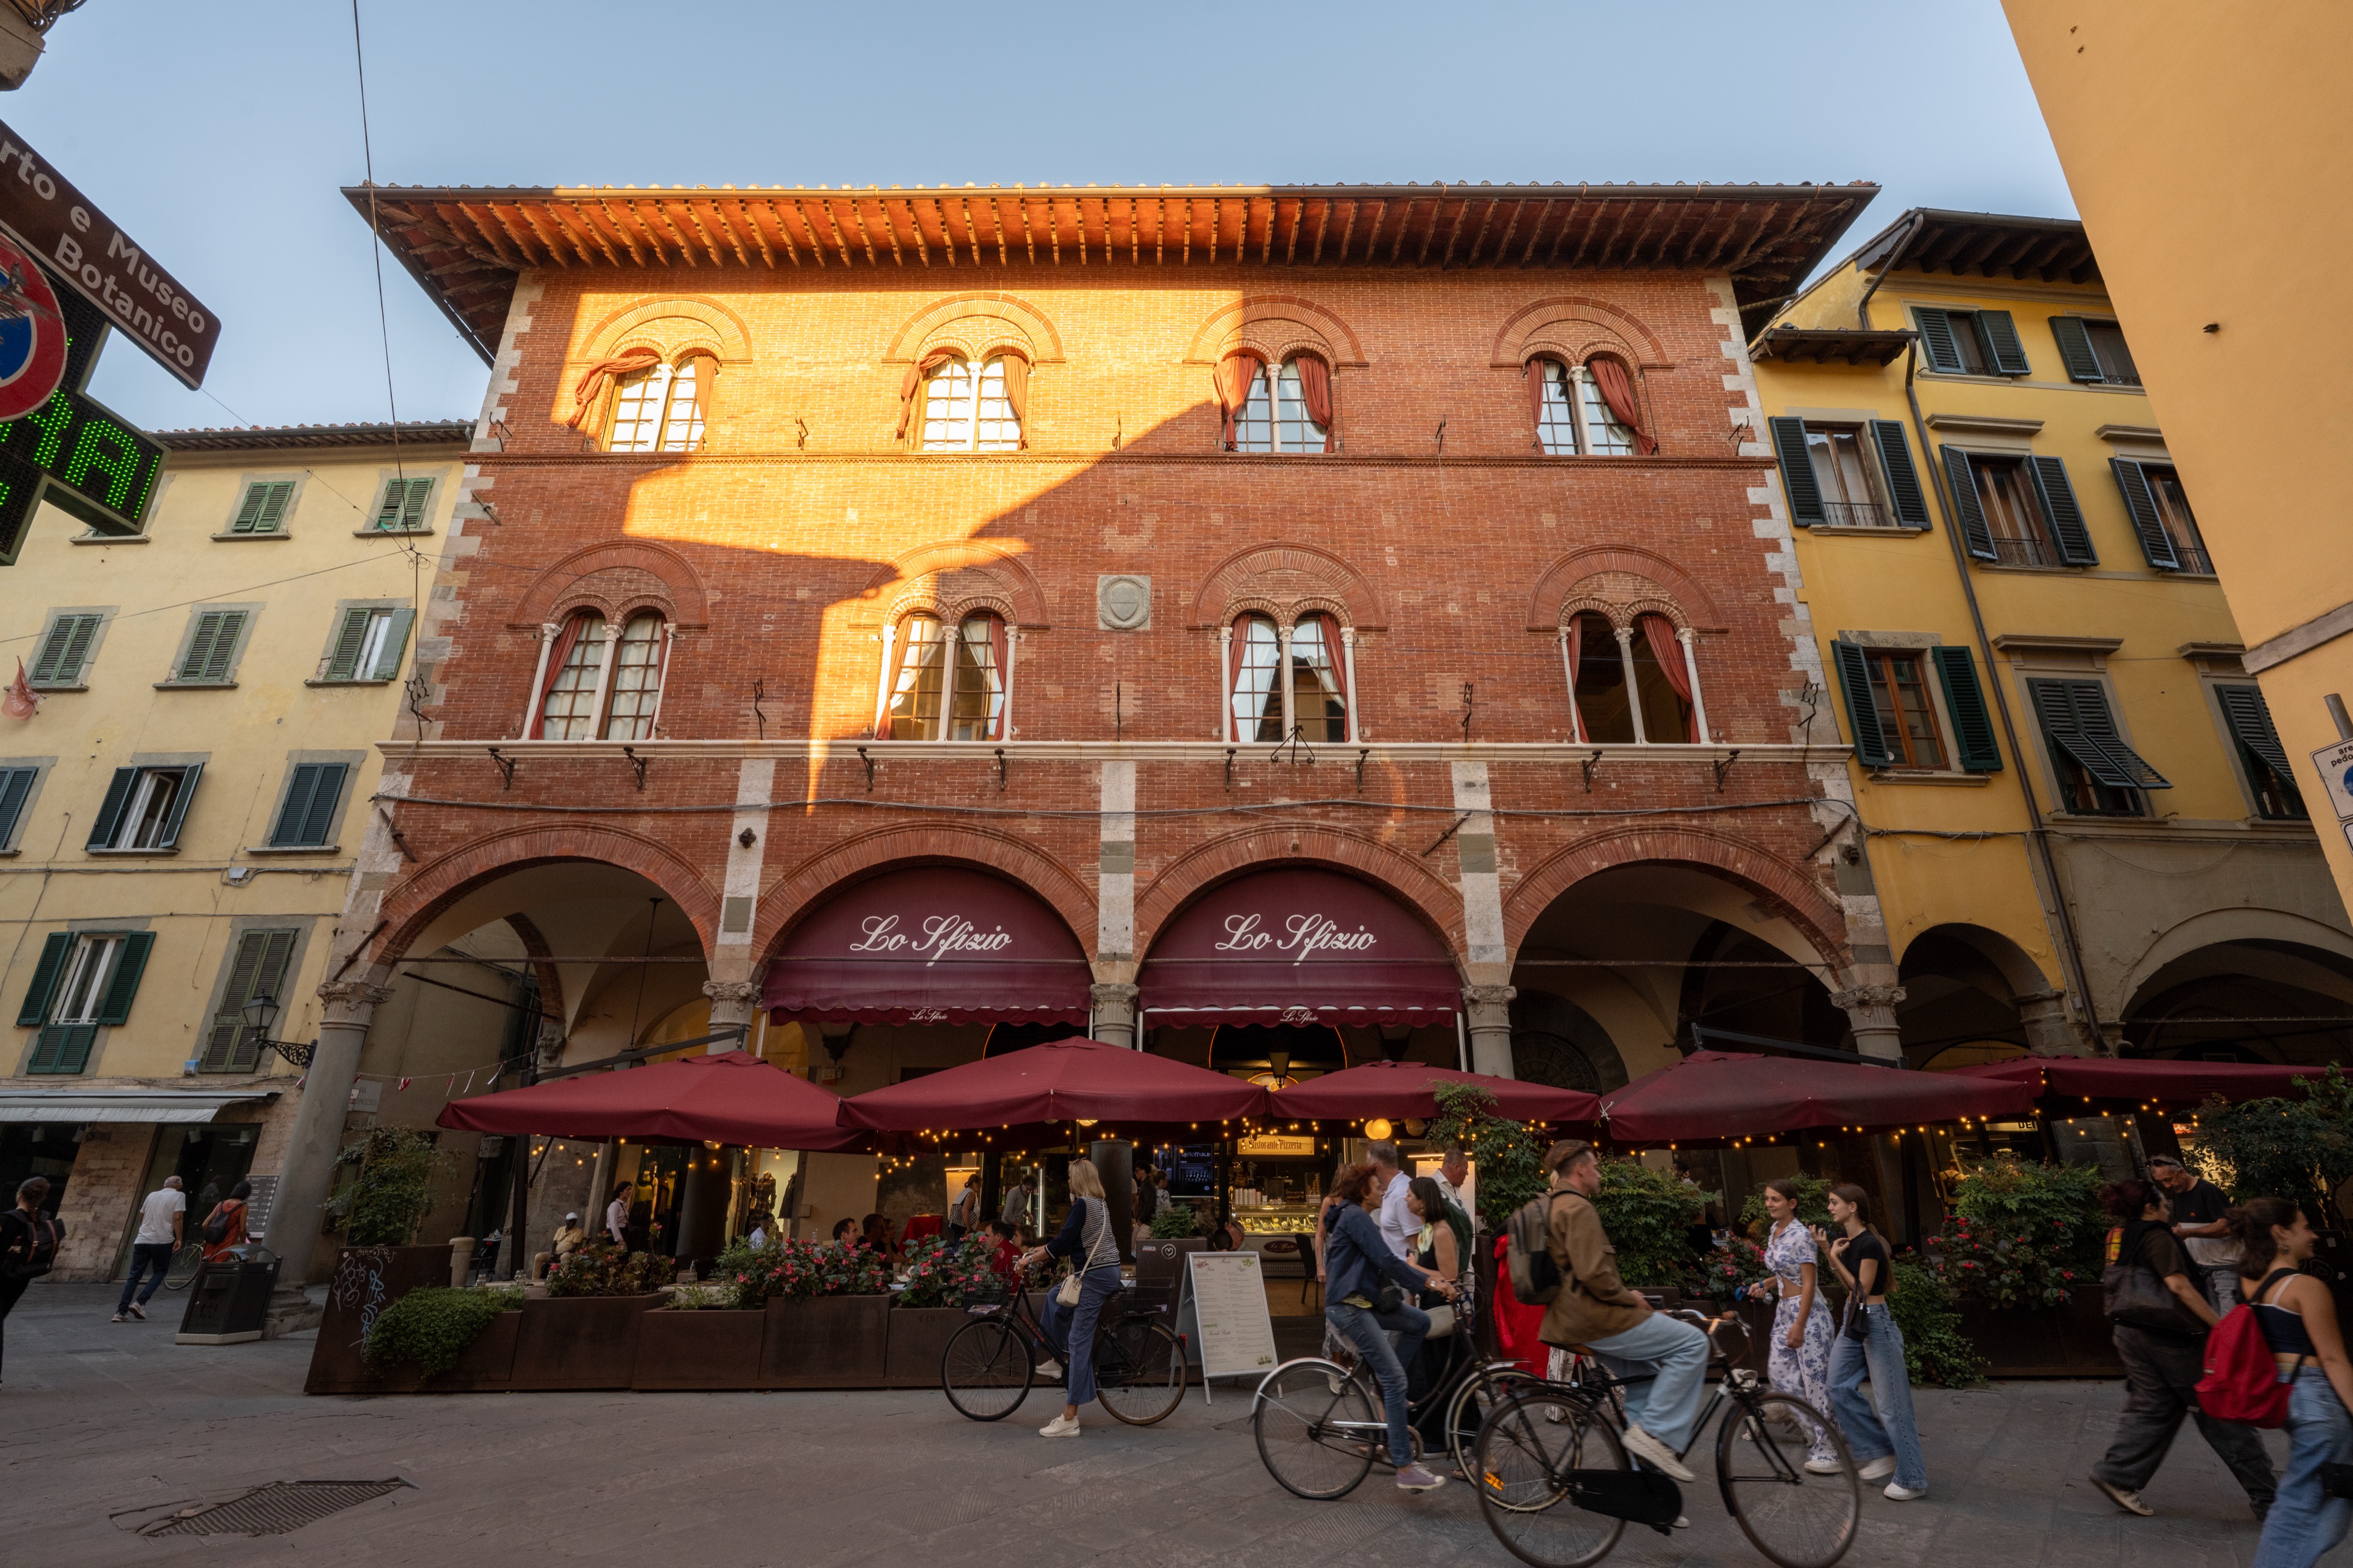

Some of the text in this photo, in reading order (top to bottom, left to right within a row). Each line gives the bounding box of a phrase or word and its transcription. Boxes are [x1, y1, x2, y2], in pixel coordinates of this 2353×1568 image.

[70, 206, 91, 233] e
[106, 230, 205, 334] Museo
[54, 232, 194, 368] Botanico
[850, 915, 1012, 967] Lo Sfizio
[1215, 914, 1377, 966] Lo Sfizio
[909, 1009, 925, 1020] Lo
[1279, 1010, 1318, 1025] Lo Sfizio
[1251, 1140, 1302, 1150] Ristorante Pizzeria
